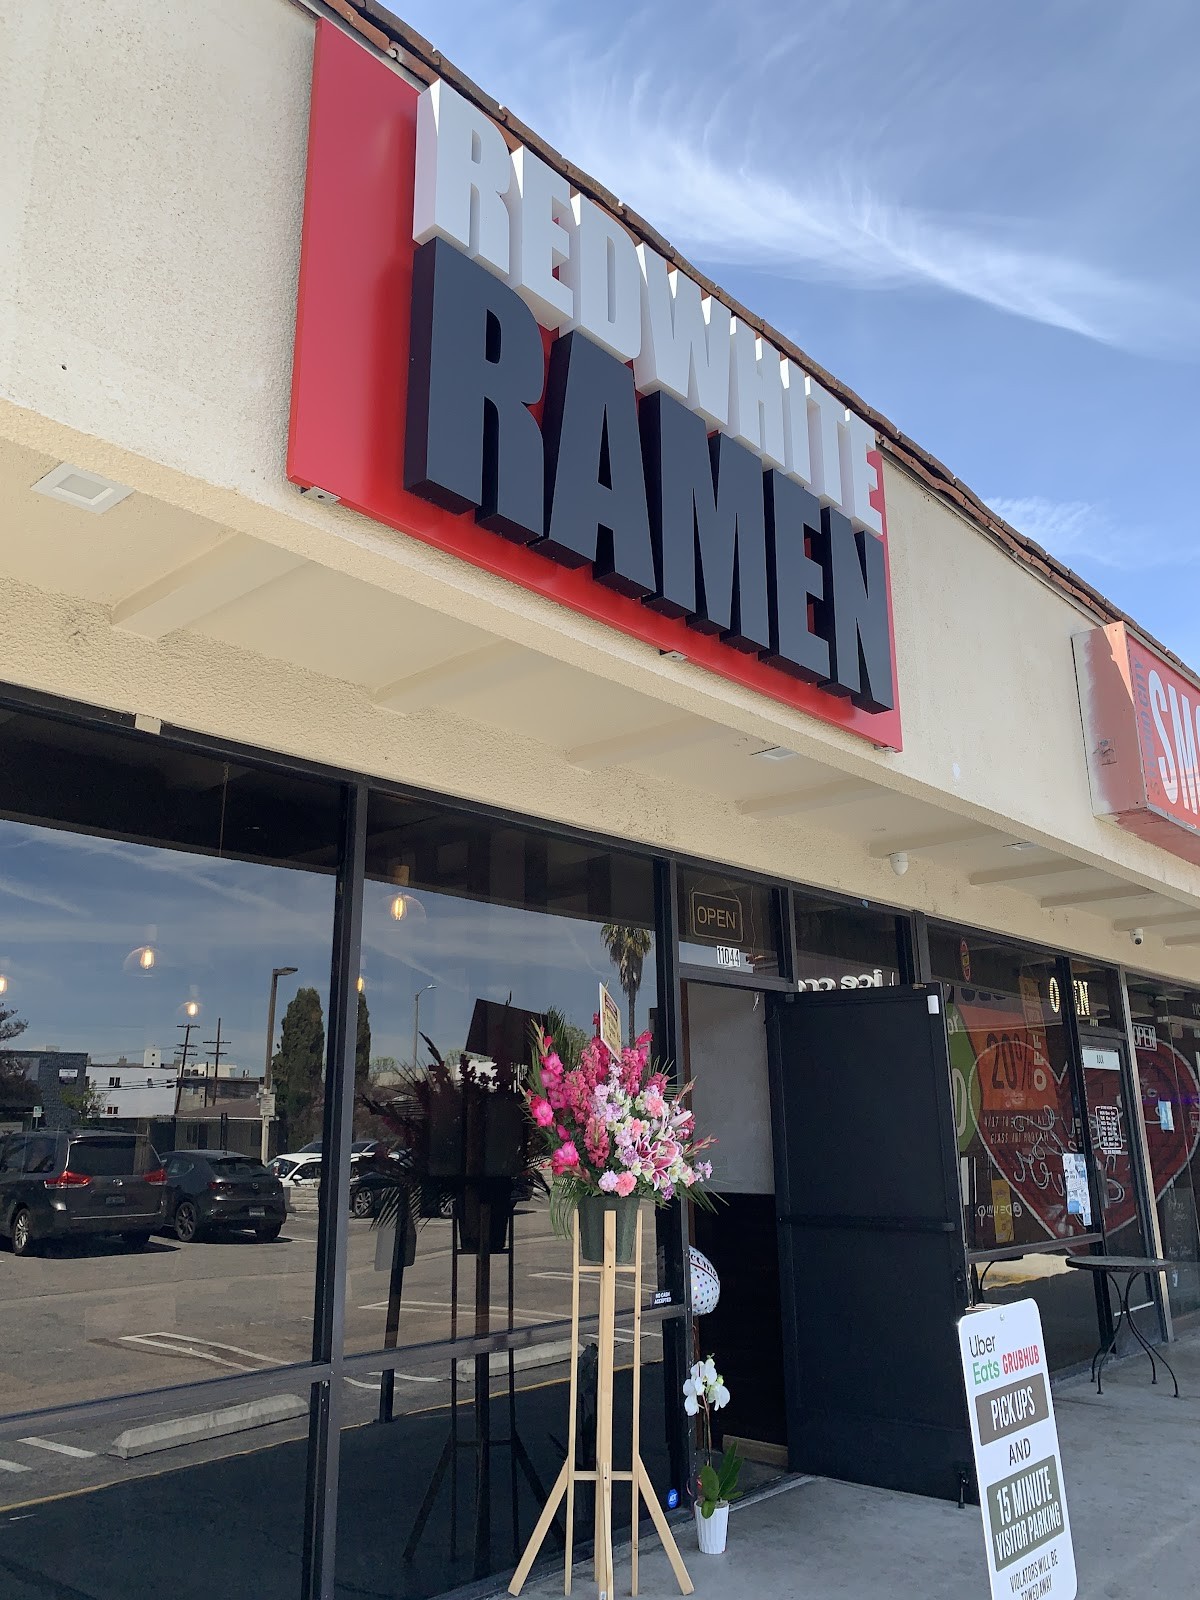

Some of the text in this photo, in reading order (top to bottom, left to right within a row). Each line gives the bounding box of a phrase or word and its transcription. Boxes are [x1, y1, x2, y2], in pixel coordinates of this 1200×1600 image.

[403, 236, 893, 713] RAMEN
[1148, 669, 1200, 815] SM
[697, 907, 736, 930] OPEN
[717, 947, 740, 967] 11044
[1132, 1026, 1155, 1048] OPEN
[986, 1032, 1047, 1091] 20% OFF
[990, 1132, 1009, 1144] GLASS
[968, 1335, 996, 1358] Uber
[973, 1344, 1040, 1385] Eats GRUBHUB
[1009, 1437, 1031, 1466] AND
[997, 1465, 1053, 1526] 15 MINUTE
[995, 1501, 1062, 1561] VISITOR PARKING
[1009, 1549, 1059, 1593] VIOLATORS WILL BE
[1039, 1574, 1053, 1597] AWAY
